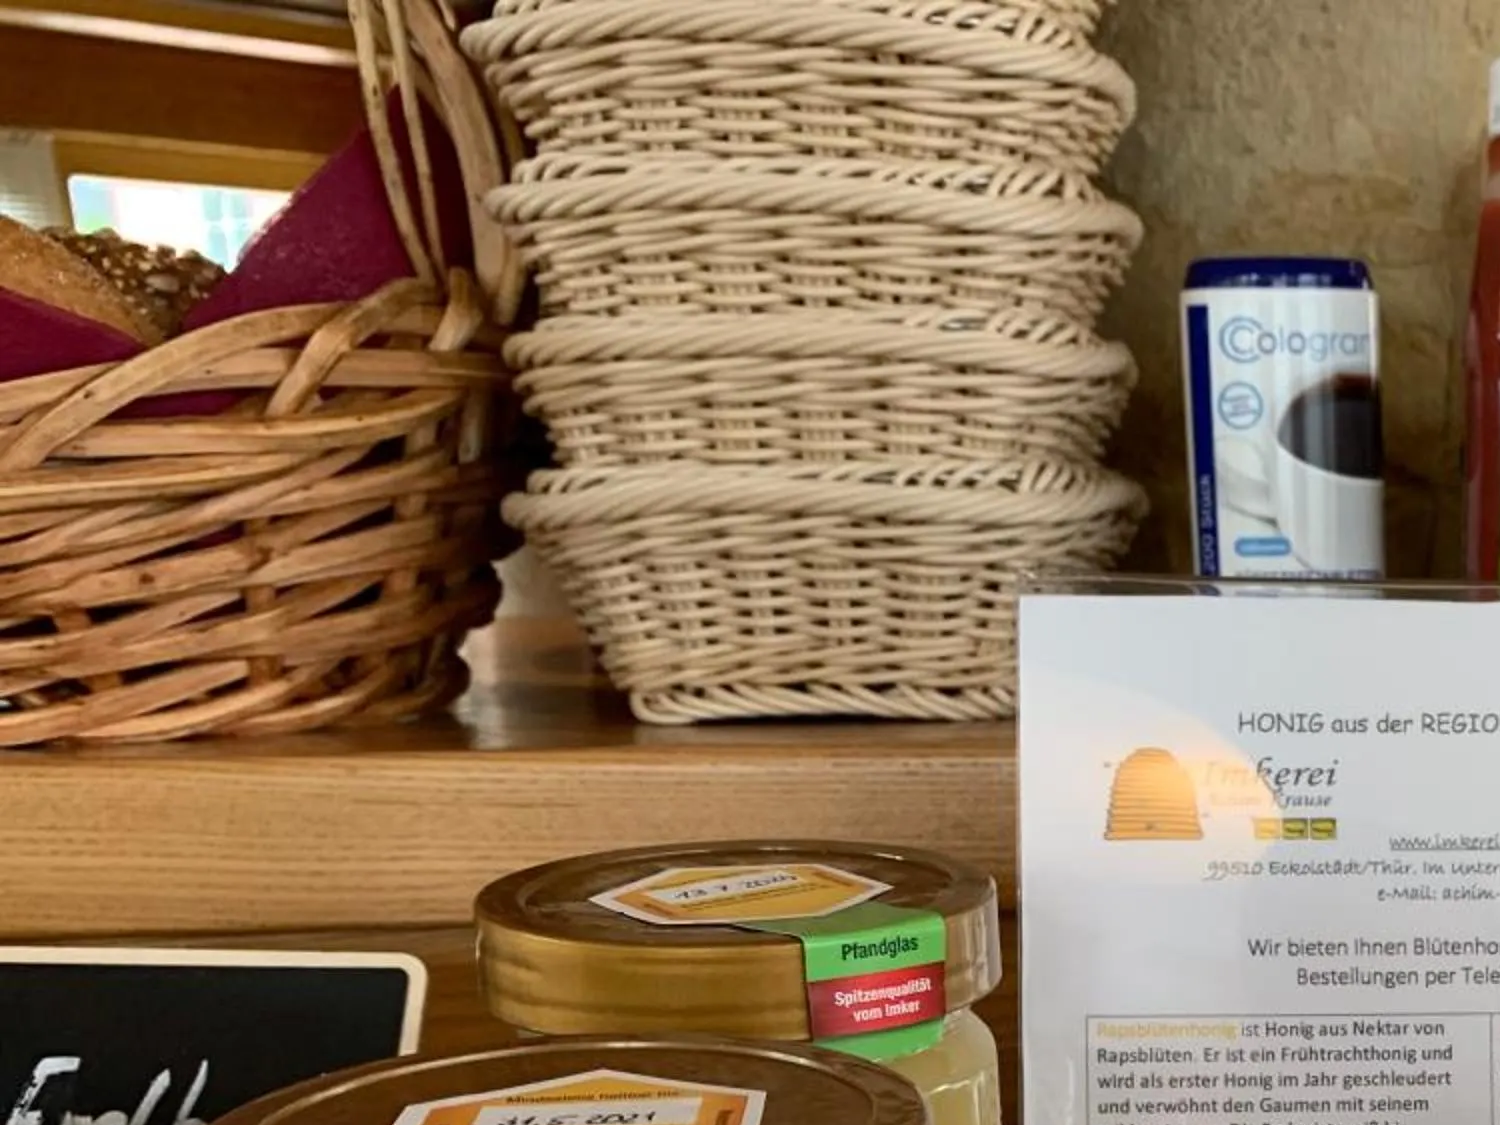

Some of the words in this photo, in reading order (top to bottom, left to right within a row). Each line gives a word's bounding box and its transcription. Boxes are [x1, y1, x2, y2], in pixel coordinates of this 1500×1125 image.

[1237, 712, 1325, 734] HONIG
[1330, 717, 1369, 734] aus
[1375, 712, 1414, 735] der
[841, 934, 919, 961] Pfandglas
[1247, 938, 1283, 957] Wir
[1287, 938, 1349, 958] bieten
[1353, 937, 1408, 957] Ihnen
[1296, 966, 1419, 990] Bestellungen
[1424, 970, 1457, 989] per
[834, 977, 931, 1007] Spitzenqualität
[853, 1006, 883, 1023] vom
[886, 1000, 920, 1019] Imker
[1240, 1023, 1261, 1038] ist
[1264, 1021, 1315, 1041] Honig
[1318, 1023, 1349, 1037] aus
[1352, 1019, 1410, 1037] Nektar
[1413, 1023, 1445, 1036] von
[1202, 1046, 1222, 1064] Er
[1225, 1047, 1246, 1064] ist
[1249, 1047, 1276, 1063] ein
[1280, 1044, 1418, 1065] Frühtrachthonig
[1420, 1044, 1454, 1061] und
[1096, 1072, 1135, 1090] wird
[1139, 1072, 1164, 1089] als
[1167, 1073, 1218, 1089] erster
[1223, 1072, 1274, 1092] Honig
[1277, 1074, 1300, 1088] im
[1303, 1071, 1338, 1088] Jahr
[1342, 1069, 1452, 1091] geschleudert
[1097, 1098, 1131, 1115] und
[1134, 1097, 1219, 1115] verwöhnt
[1221, 1096, 1255, 1114] den
[1258, 1096, 1332, 1114] Gaumen
[1335, 1097, 1365, 1113] mit
[1368, 1096, 1430, 1113] seinem
